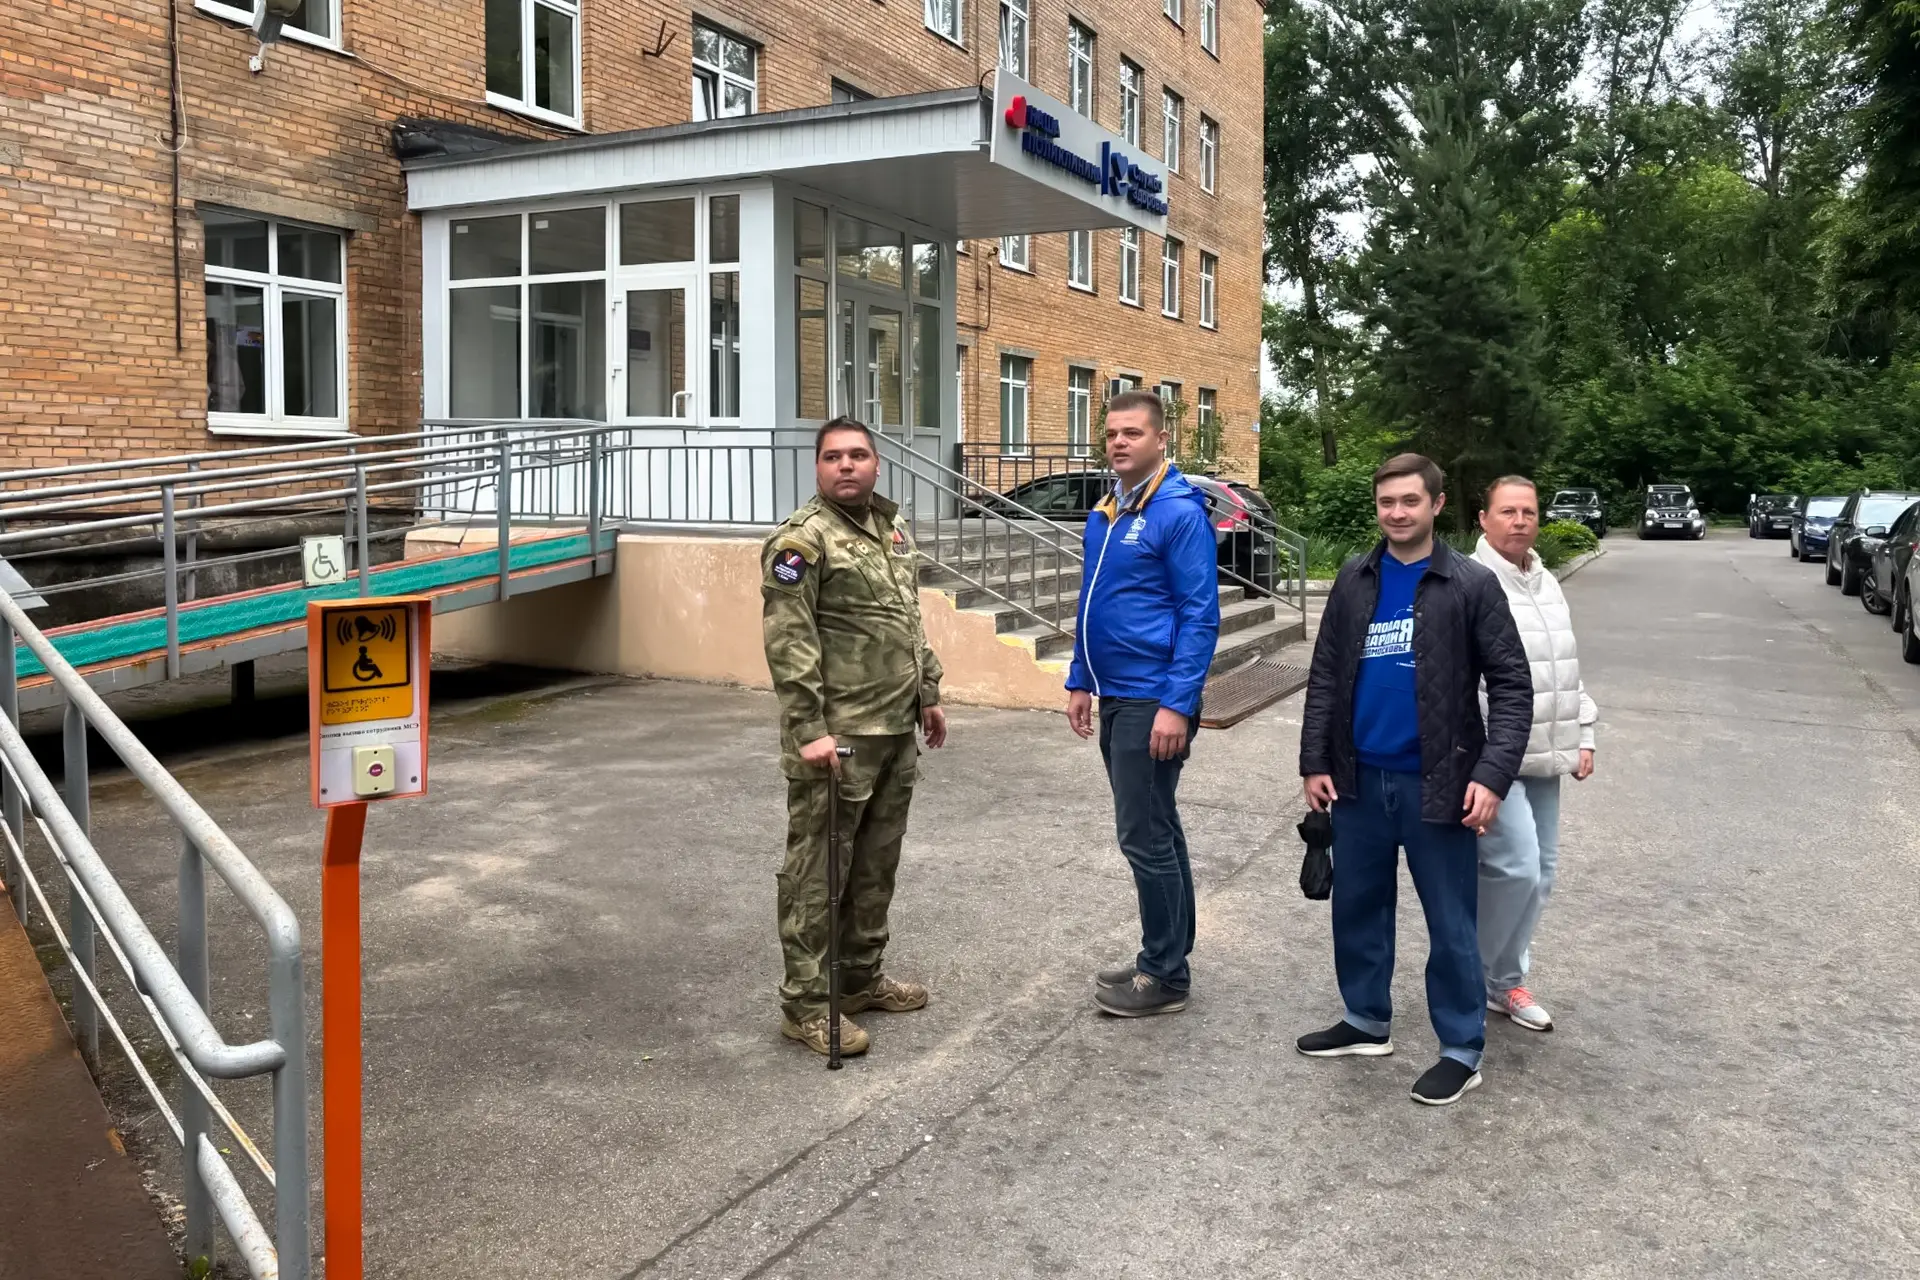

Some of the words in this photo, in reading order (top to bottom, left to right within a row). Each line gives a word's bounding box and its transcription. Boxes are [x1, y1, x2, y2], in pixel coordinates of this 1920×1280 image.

[1026, 105, 1060, 138] НАША
[1128, 164, 1162, 193] Служба
[1368, 619, 1413, 642] ОЛОДАЯ
